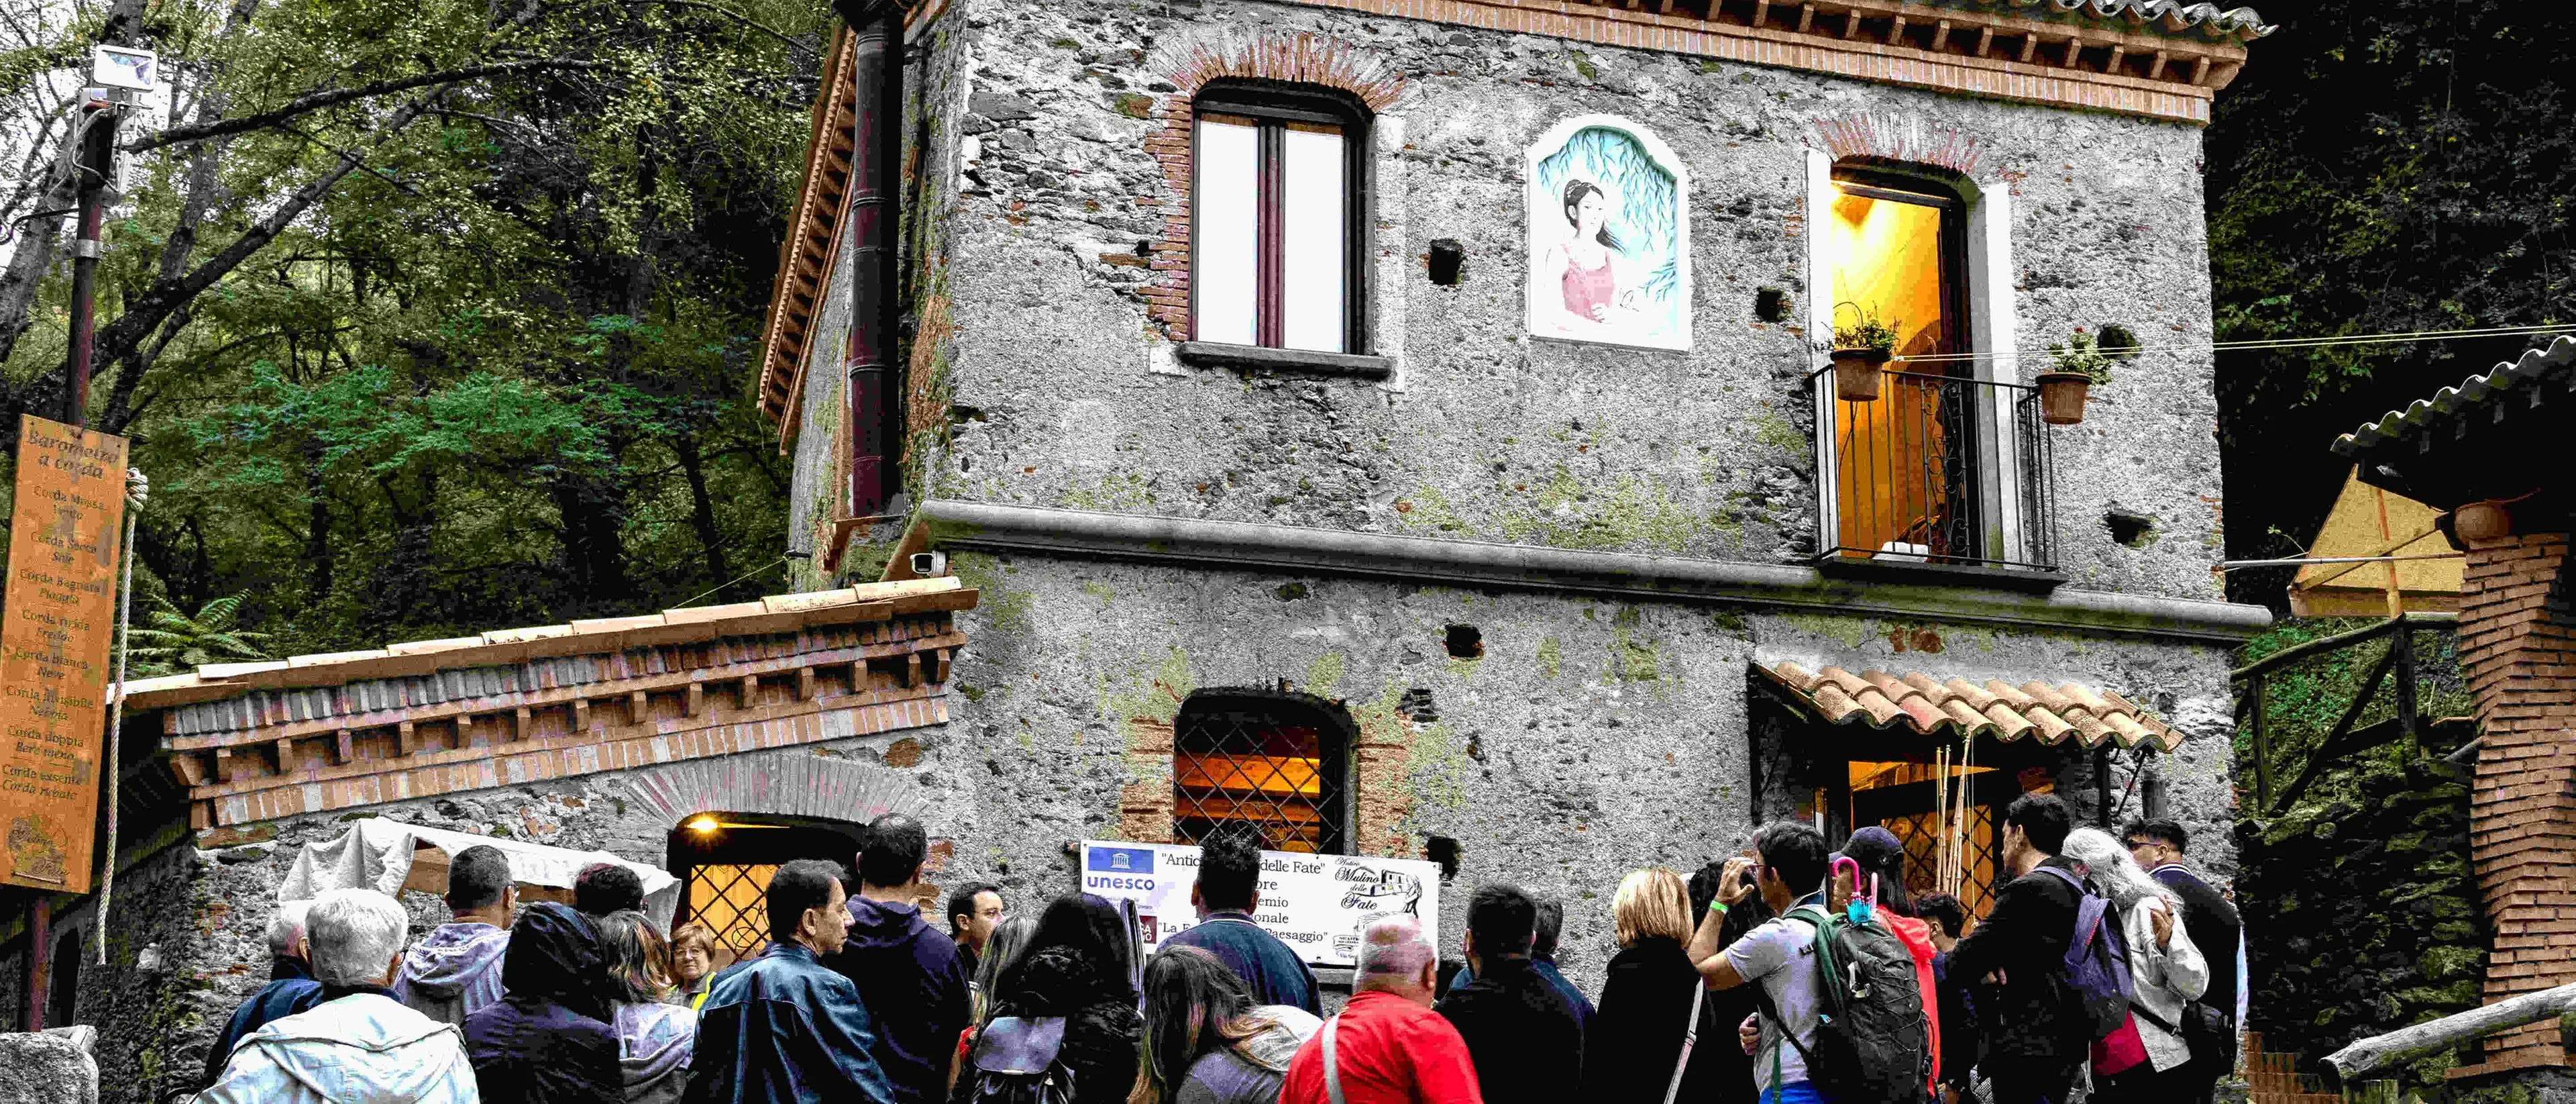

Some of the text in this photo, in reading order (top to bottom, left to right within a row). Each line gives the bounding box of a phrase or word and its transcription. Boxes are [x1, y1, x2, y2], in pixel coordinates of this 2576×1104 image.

[19, 568, 53, 585] Corda
[22, 609, 56, 625] Corda
[15, 646, 49, 662] Corda
[6, 685, 40, 701] Corda
[6, 725, 42, 740] Corda
[2, 764, 37, 779] Corda
[2, 779, 36, 795] Corda
[1161, 852, 1201, 867] "Antic
[1260, 859, 1326, 874] delle Fate"
[1334, 866, 1380, 884] Mulino
[1087, 876, 1155, 891] unesco
[1257, 896, 1289, 908] emio
[1341, 891, 1377, 910] Fate
